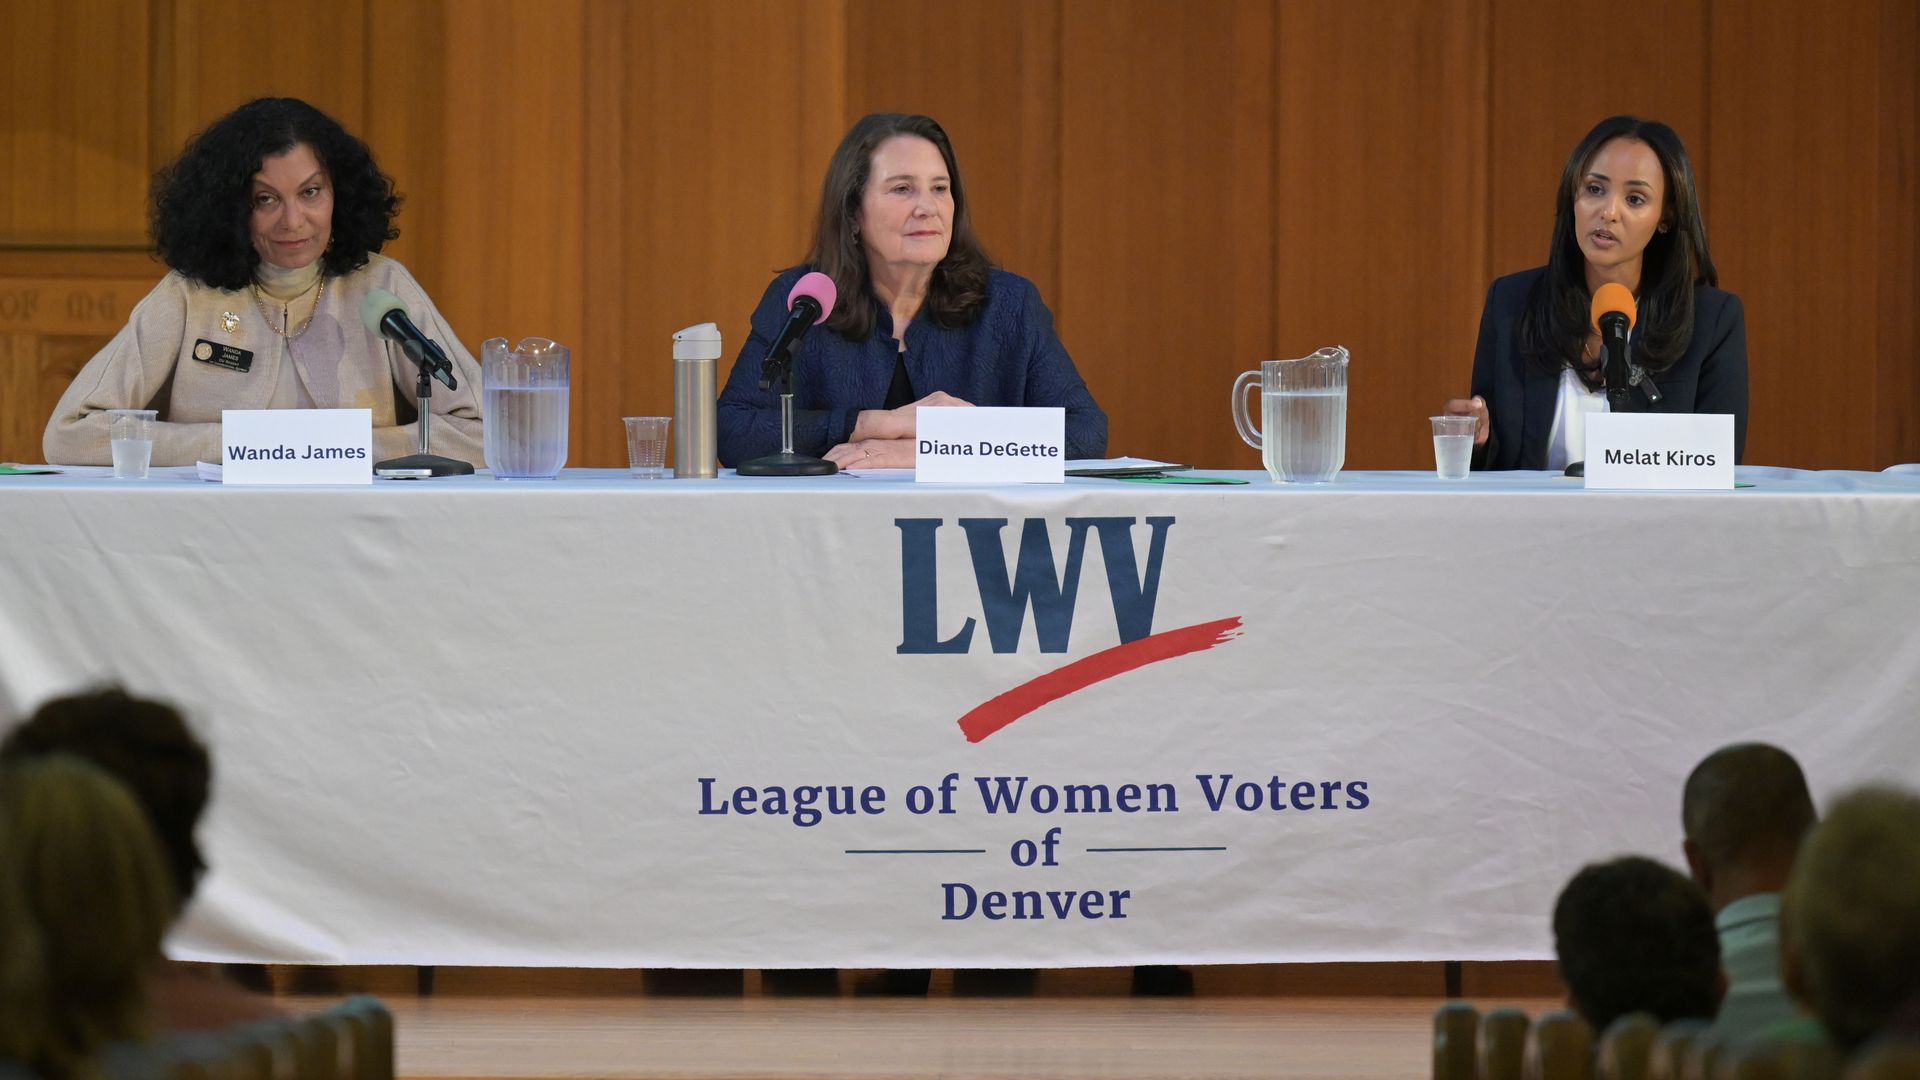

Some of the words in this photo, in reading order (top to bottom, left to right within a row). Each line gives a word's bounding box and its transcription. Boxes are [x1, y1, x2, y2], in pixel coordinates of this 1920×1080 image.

[222, 353, 239, 361] JAMES
[223, 346, 242, 355] WANDA
[227, 444, 297, 461] Wanda
[300, 444, 366, 461] James
[919, 439, 974, 457] Diana
[979, 441, 1059, 458] DeGette
[1604, 448, 1661, 466] Melat
[1666, 449, 1716, 467] Kiros
[894, 515, 1176, 655] LWV
[697, 777, 886, 828] League
[905, 772, 960, 815] of
[973, 776, 1179, 813] Women
[1195, 774, 1370, 812] Voters
[1010, 826, 1062, 867] of
[941, 882, 1131, 921] Denver
